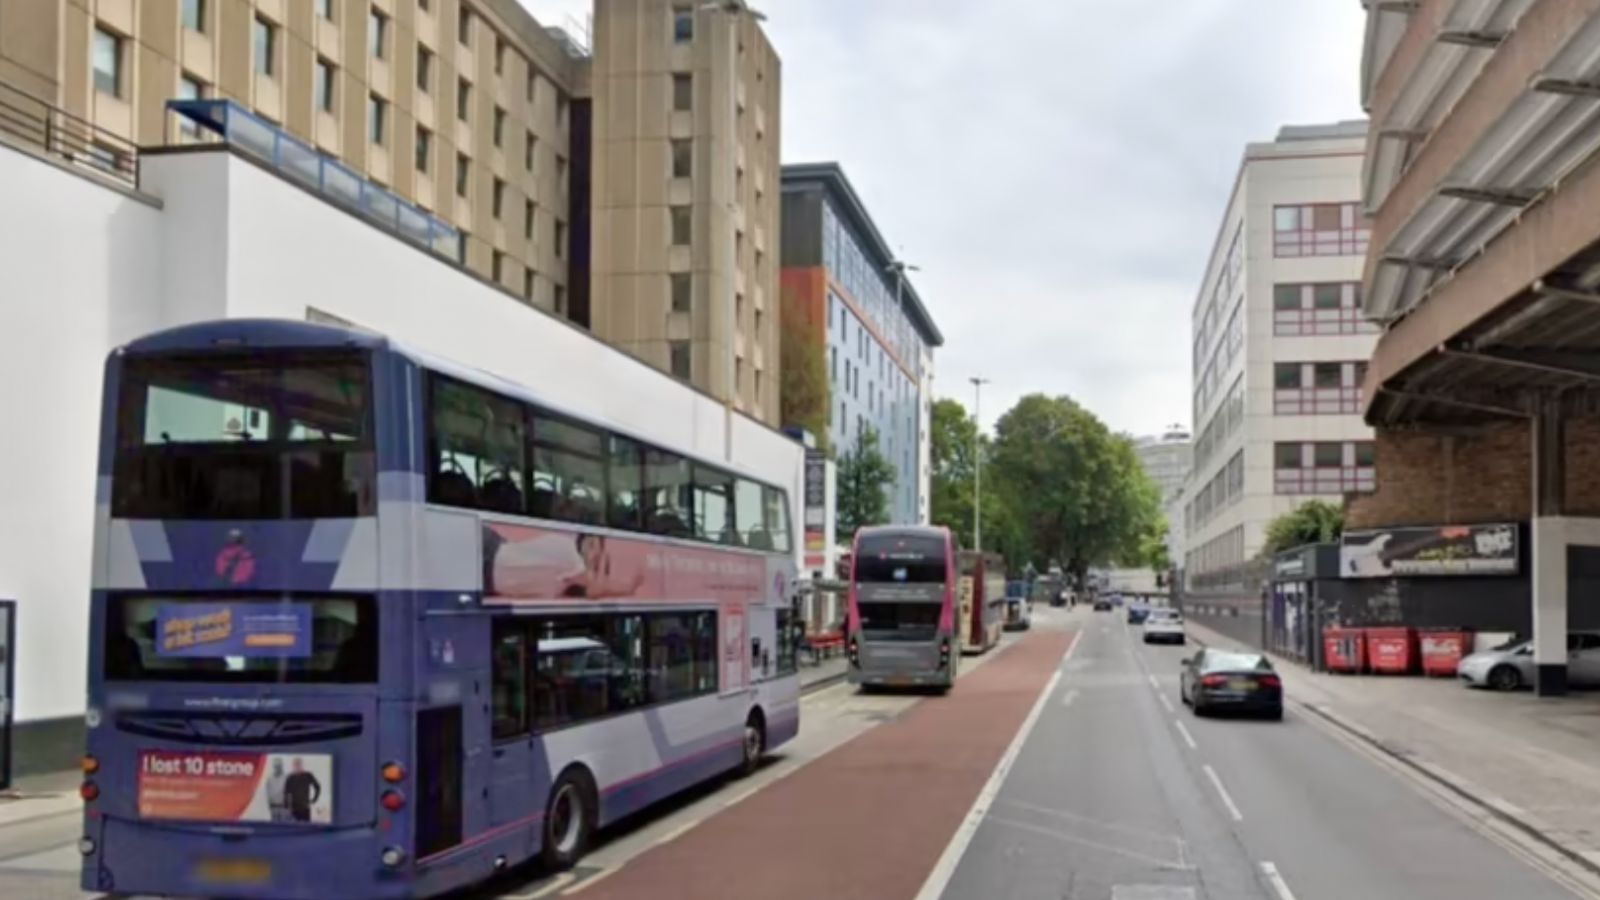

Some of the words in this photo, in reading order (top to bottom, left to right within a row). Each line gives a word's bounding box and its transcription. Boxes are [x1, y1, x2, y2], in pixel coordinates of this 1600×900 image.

[151, 754, 181, 774] lost
[184, 756, 204, 775] 10
[206, 759, 255, 777] stone
